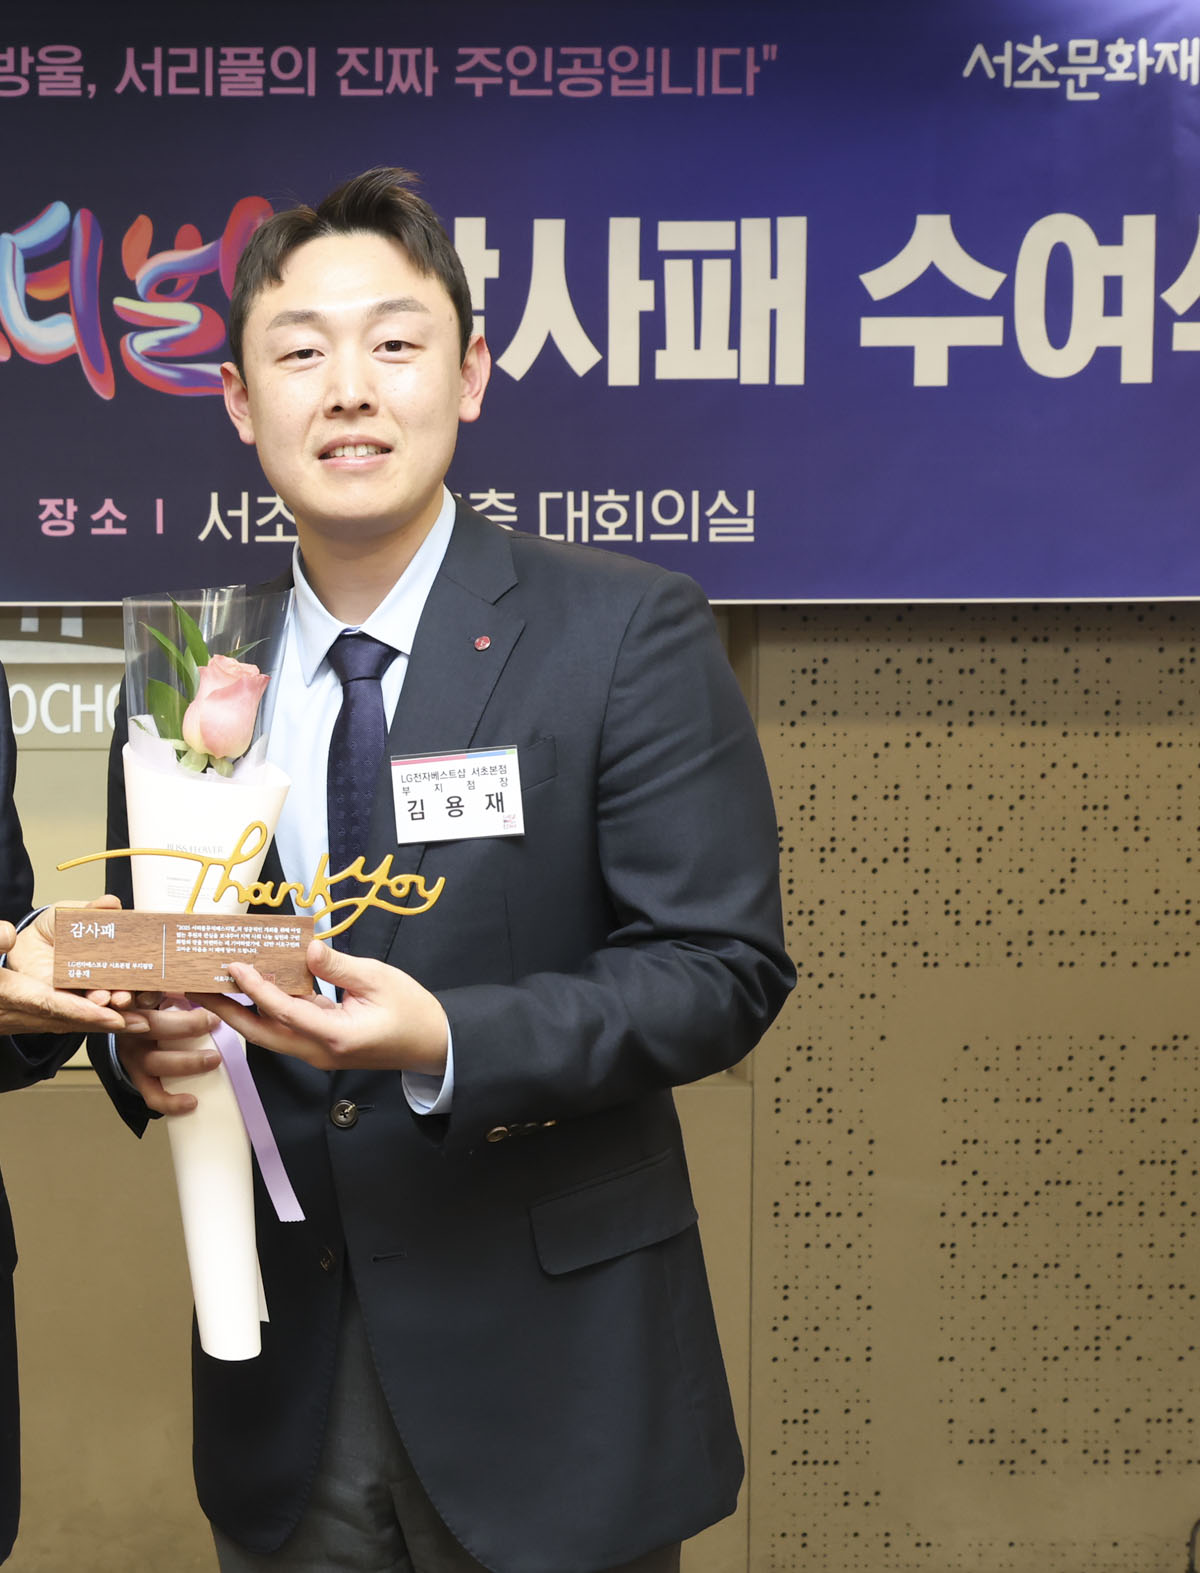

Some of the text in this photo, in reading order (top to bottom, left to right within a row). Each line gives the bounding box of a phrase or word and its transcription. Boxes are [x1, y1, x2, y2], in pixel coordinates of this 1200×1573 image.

[114, 45, 316, 96] 서리풀의
[335, 46, 439, 96] 진짜
[454, 44, 778, 98] 주인공입니다"
[539, 489, 755, 544] 대회의실
[471, 764, 507, 777] 서초본점
[57, 821, 333, 915] Thank
[70, 921, 116, 939] 감사패
